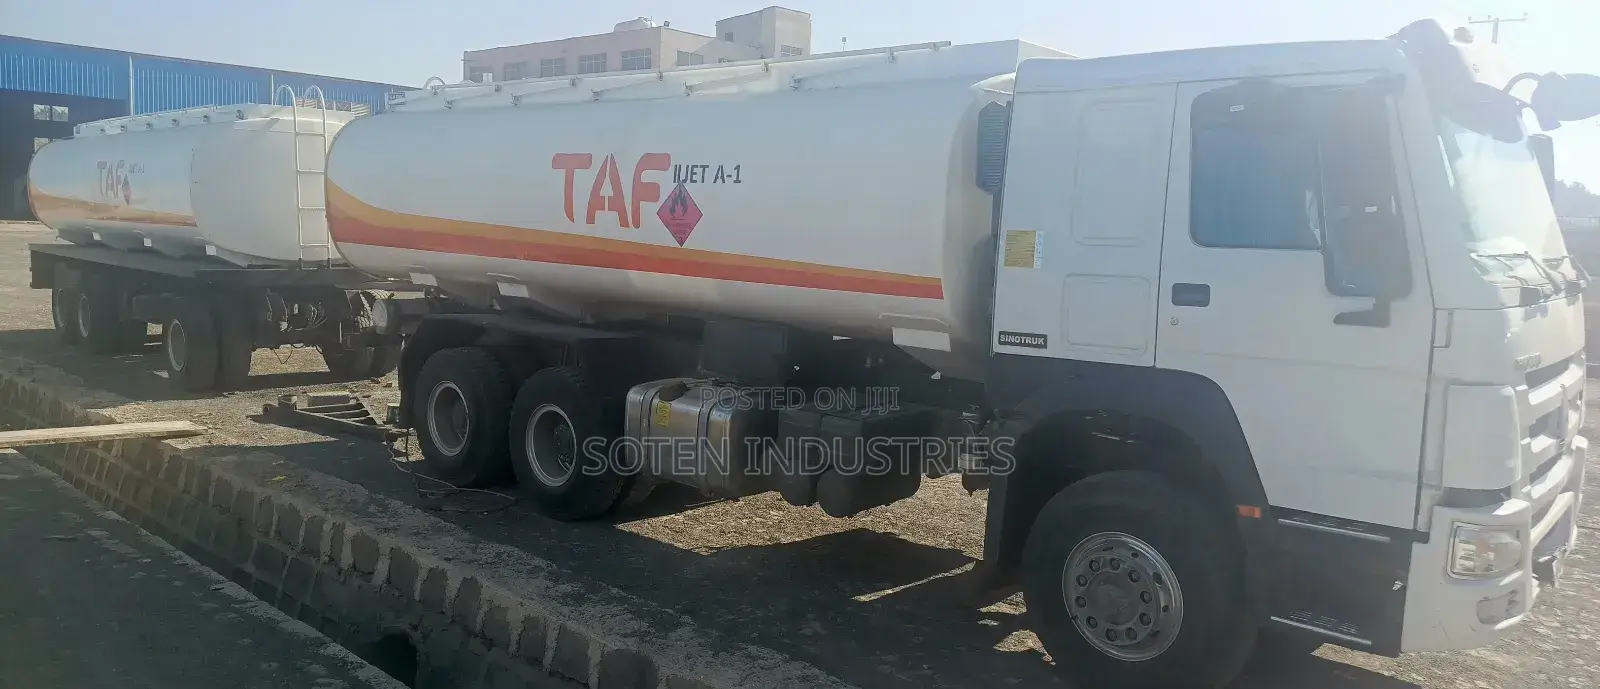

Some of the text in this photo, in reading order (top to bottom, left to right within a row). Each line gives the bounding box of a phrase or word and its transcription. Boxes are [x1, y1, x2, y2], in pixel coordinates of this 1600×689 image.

[97, 160, 124, 199] TAF
[713, 164, 742, 184] A-1
[552, 153, 671, 229] TAF
[1000, 334, 1045, 346] SINOTRUK
